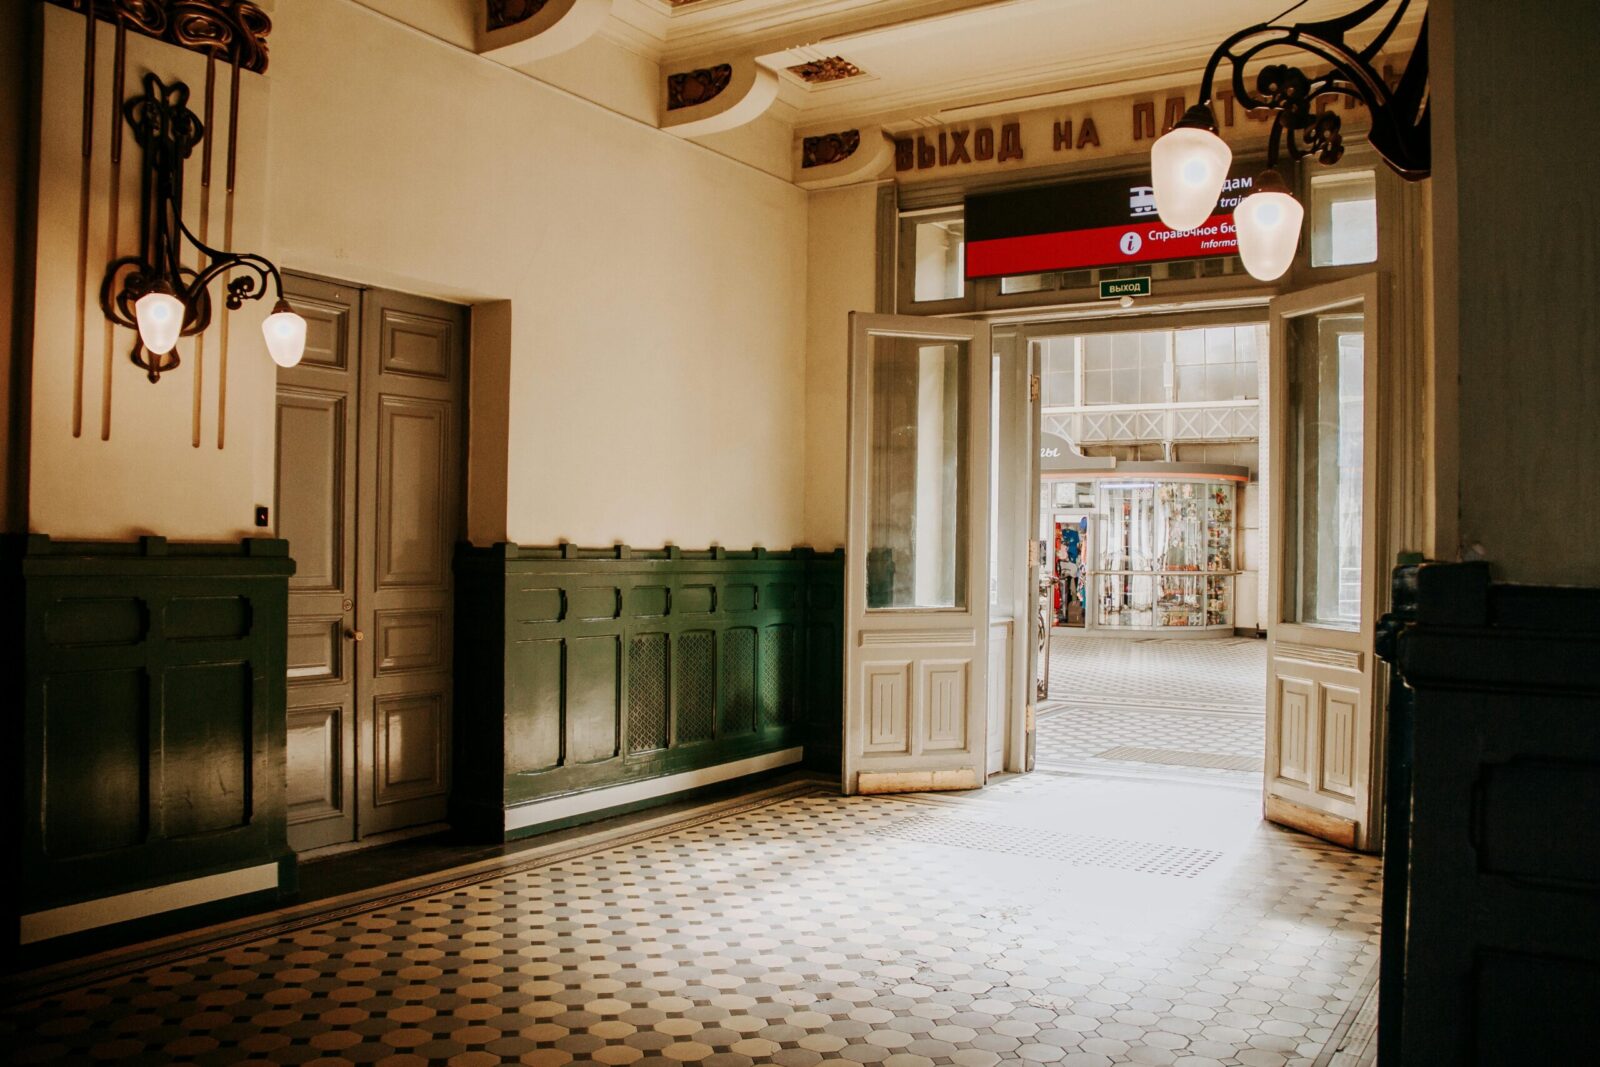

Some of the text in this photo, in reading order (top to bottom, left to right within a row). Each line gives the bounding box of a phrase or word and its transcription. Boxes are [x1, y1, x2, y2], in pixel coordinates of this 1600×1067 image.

[895, 117, 1101, 172] ВЫХОД НА
[1220, 195, 1244, 208] trai
[1148, 222, 1238, 242] Справочное бю
[1200, 239, 1239, 249] Informa
[1109, 282, 1141, 294] ВЫХОД
